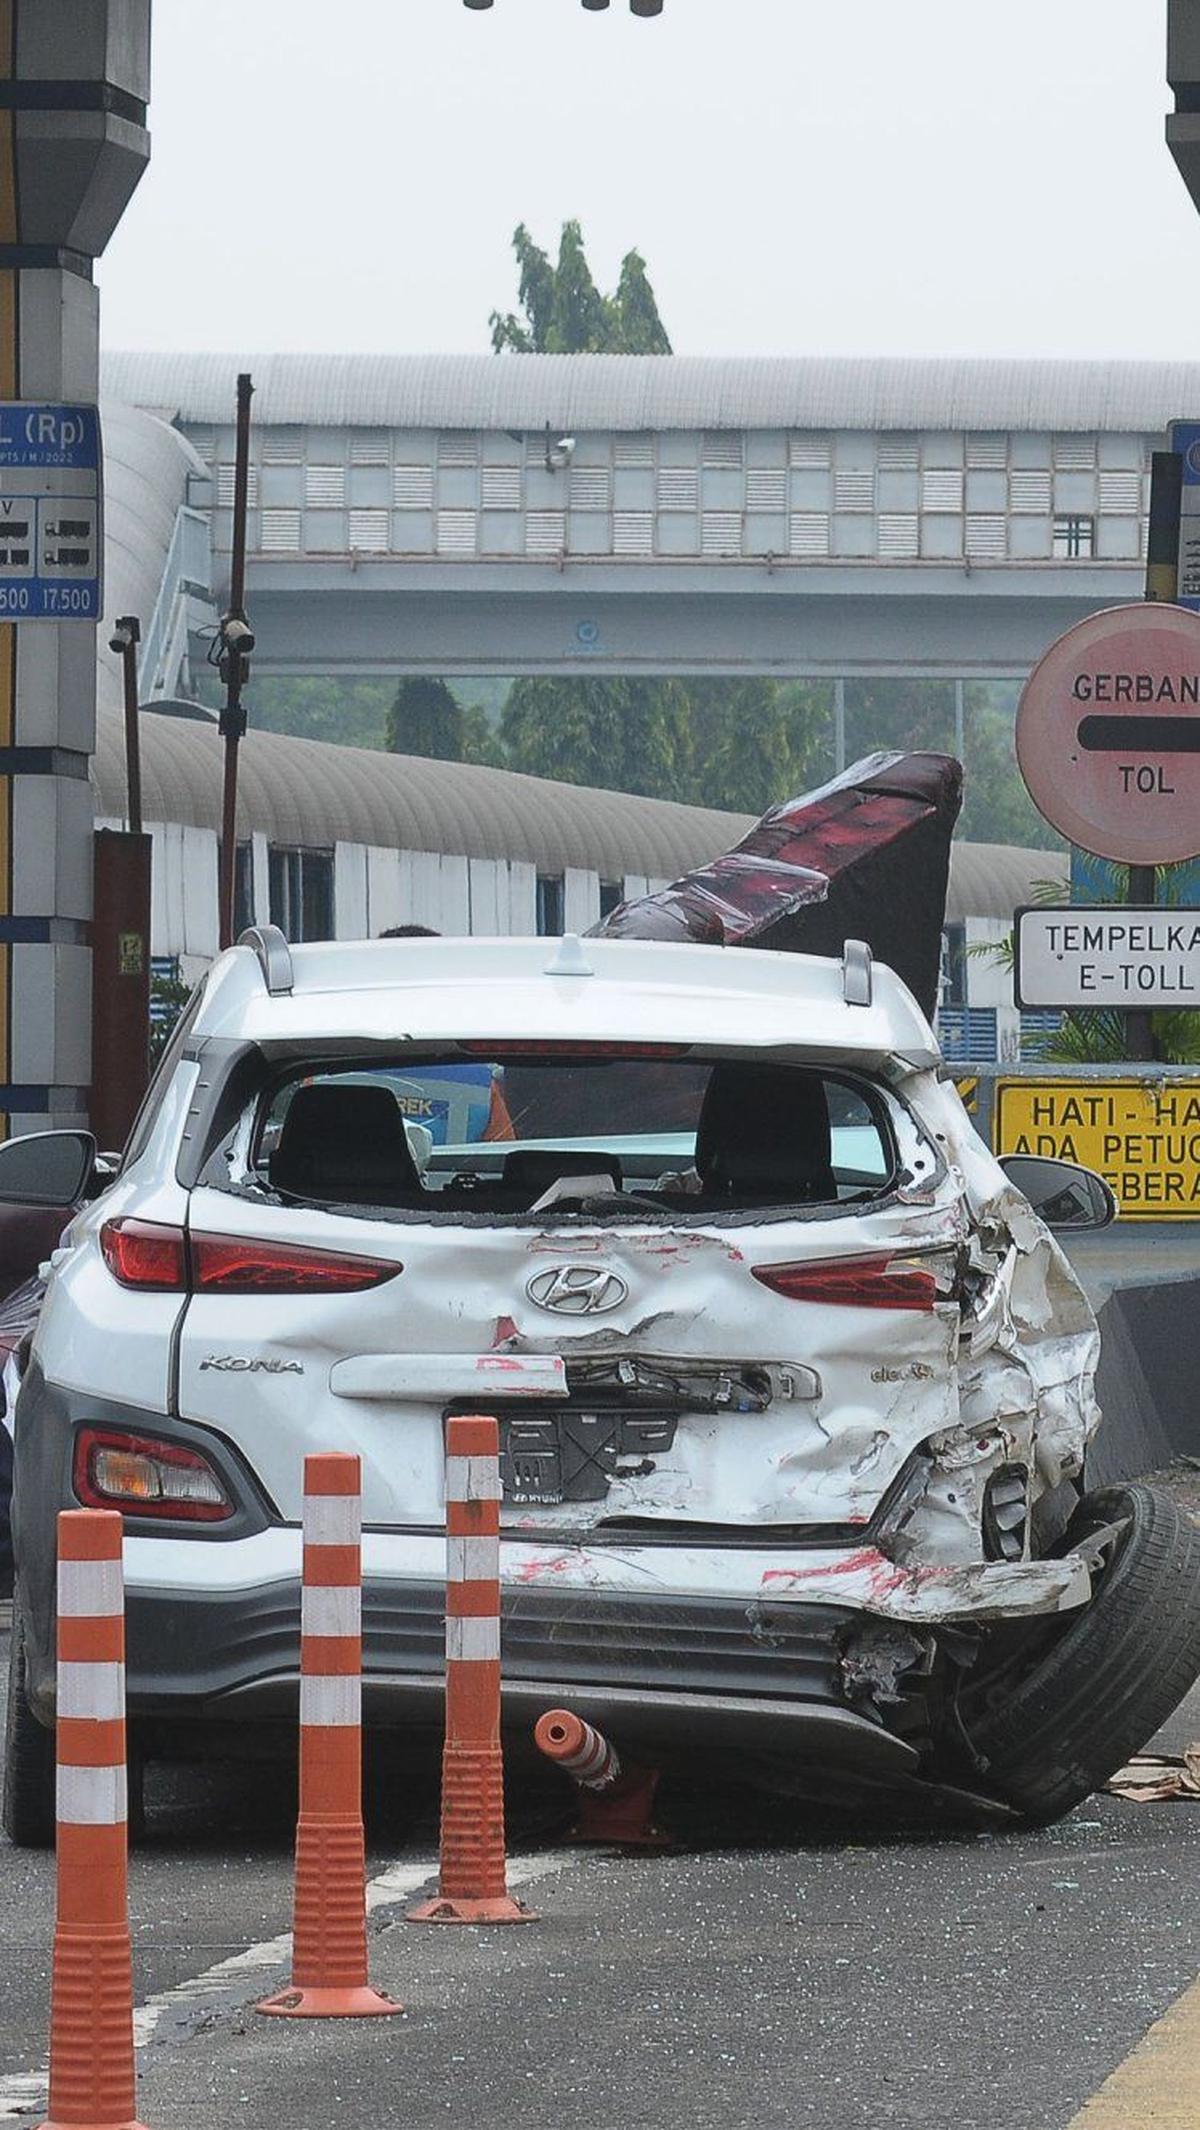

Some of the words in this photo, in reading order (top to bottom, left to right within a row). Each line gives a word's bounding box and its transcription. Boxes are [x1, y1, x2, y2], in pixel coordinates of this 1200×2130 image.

[25, 413, 84, 450] (Rp)
[43, 588, 90, 610] 17.500
[1073, 674, 1198, 702] GERBAN
[1119, 766, 1175, 793] TOL
[1046, 926, 1200, 951] TEMPELKA
[1080, 964, 1194, 990] E-TOLL
[1015, 1134, 1079, 1163] ADA
[199, 1355, 304, 1375] KONA
